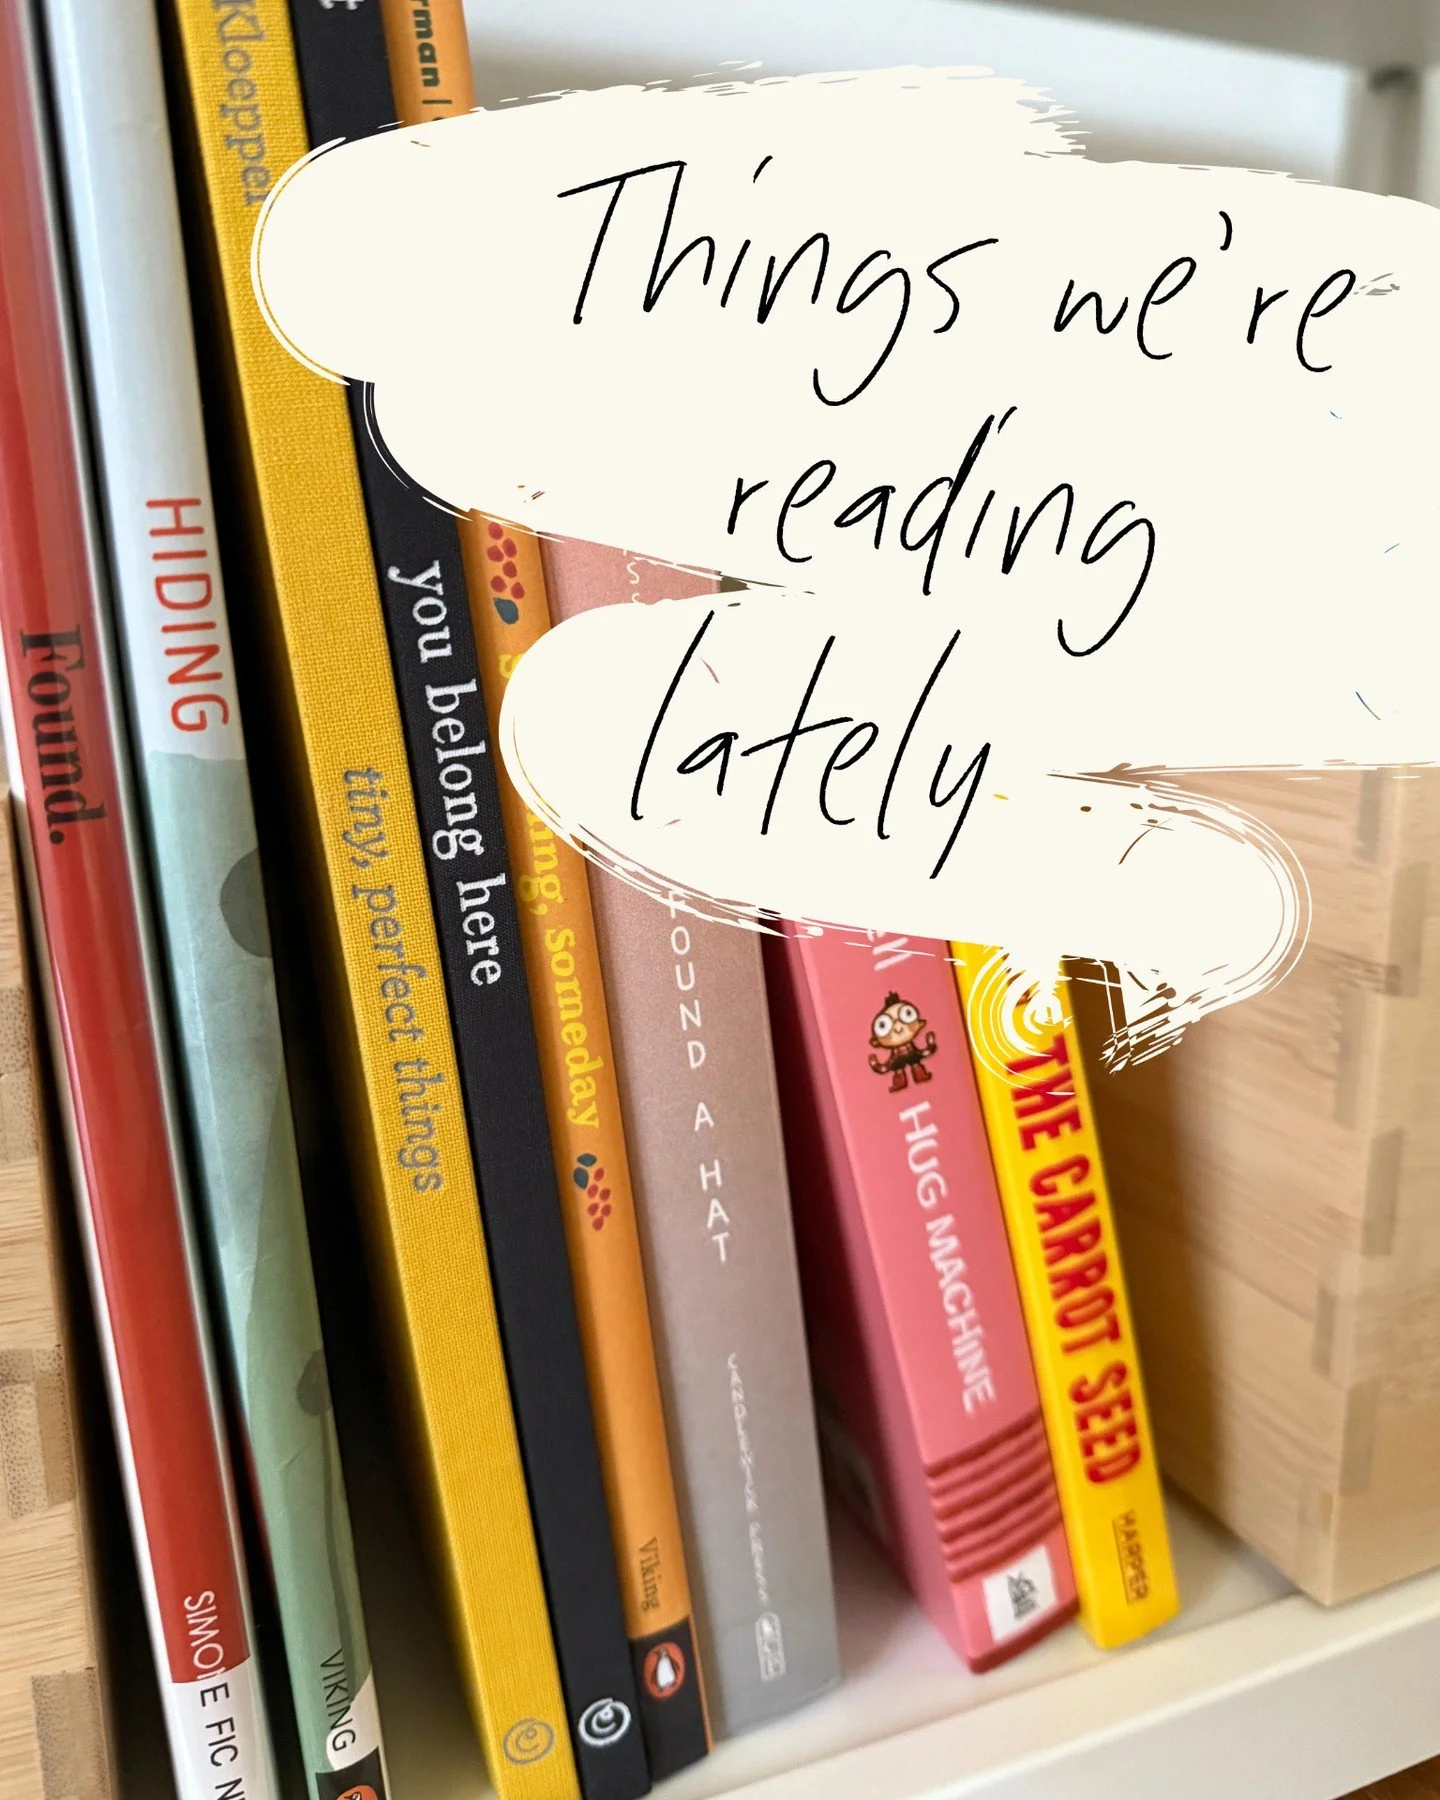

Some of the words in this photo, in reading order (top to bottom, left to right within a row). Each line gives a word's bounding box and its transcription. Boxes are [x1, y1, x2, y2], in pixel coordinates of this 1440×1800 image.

[145, 497, 230, 733] HIDING
[21, 624, 107, 845] Found.
[387, 558, 454, 664] you
[424, 678, 488, 861] belong
[456, 872, 507, 987] here
[340, 766, 392, 870] tiny,
[350, 884, 428, 1043] perfect
[544, 926, 604, 1130] someday
[1004, 1030, 1083, 1152] THE
[392, 1058, 446, 1194] things
[694, 1102, 714, 1132] A
[700, 1159, 730, 1264] HAT
[899, 1100, 948, 1210] HUG
[924, 1212, 997, 1415] MACHINE
[1028, 1153, 1121, 1355] CARROT
[1068, 1358, 1143, 1486] SEED
[639, 1535, 662, 1612] Viking
[1120, 1508, 1149, 1600] HARPER
[205, 1716, 239, 1767] FIC
[320, 1649, 357, 1752] VIKING
